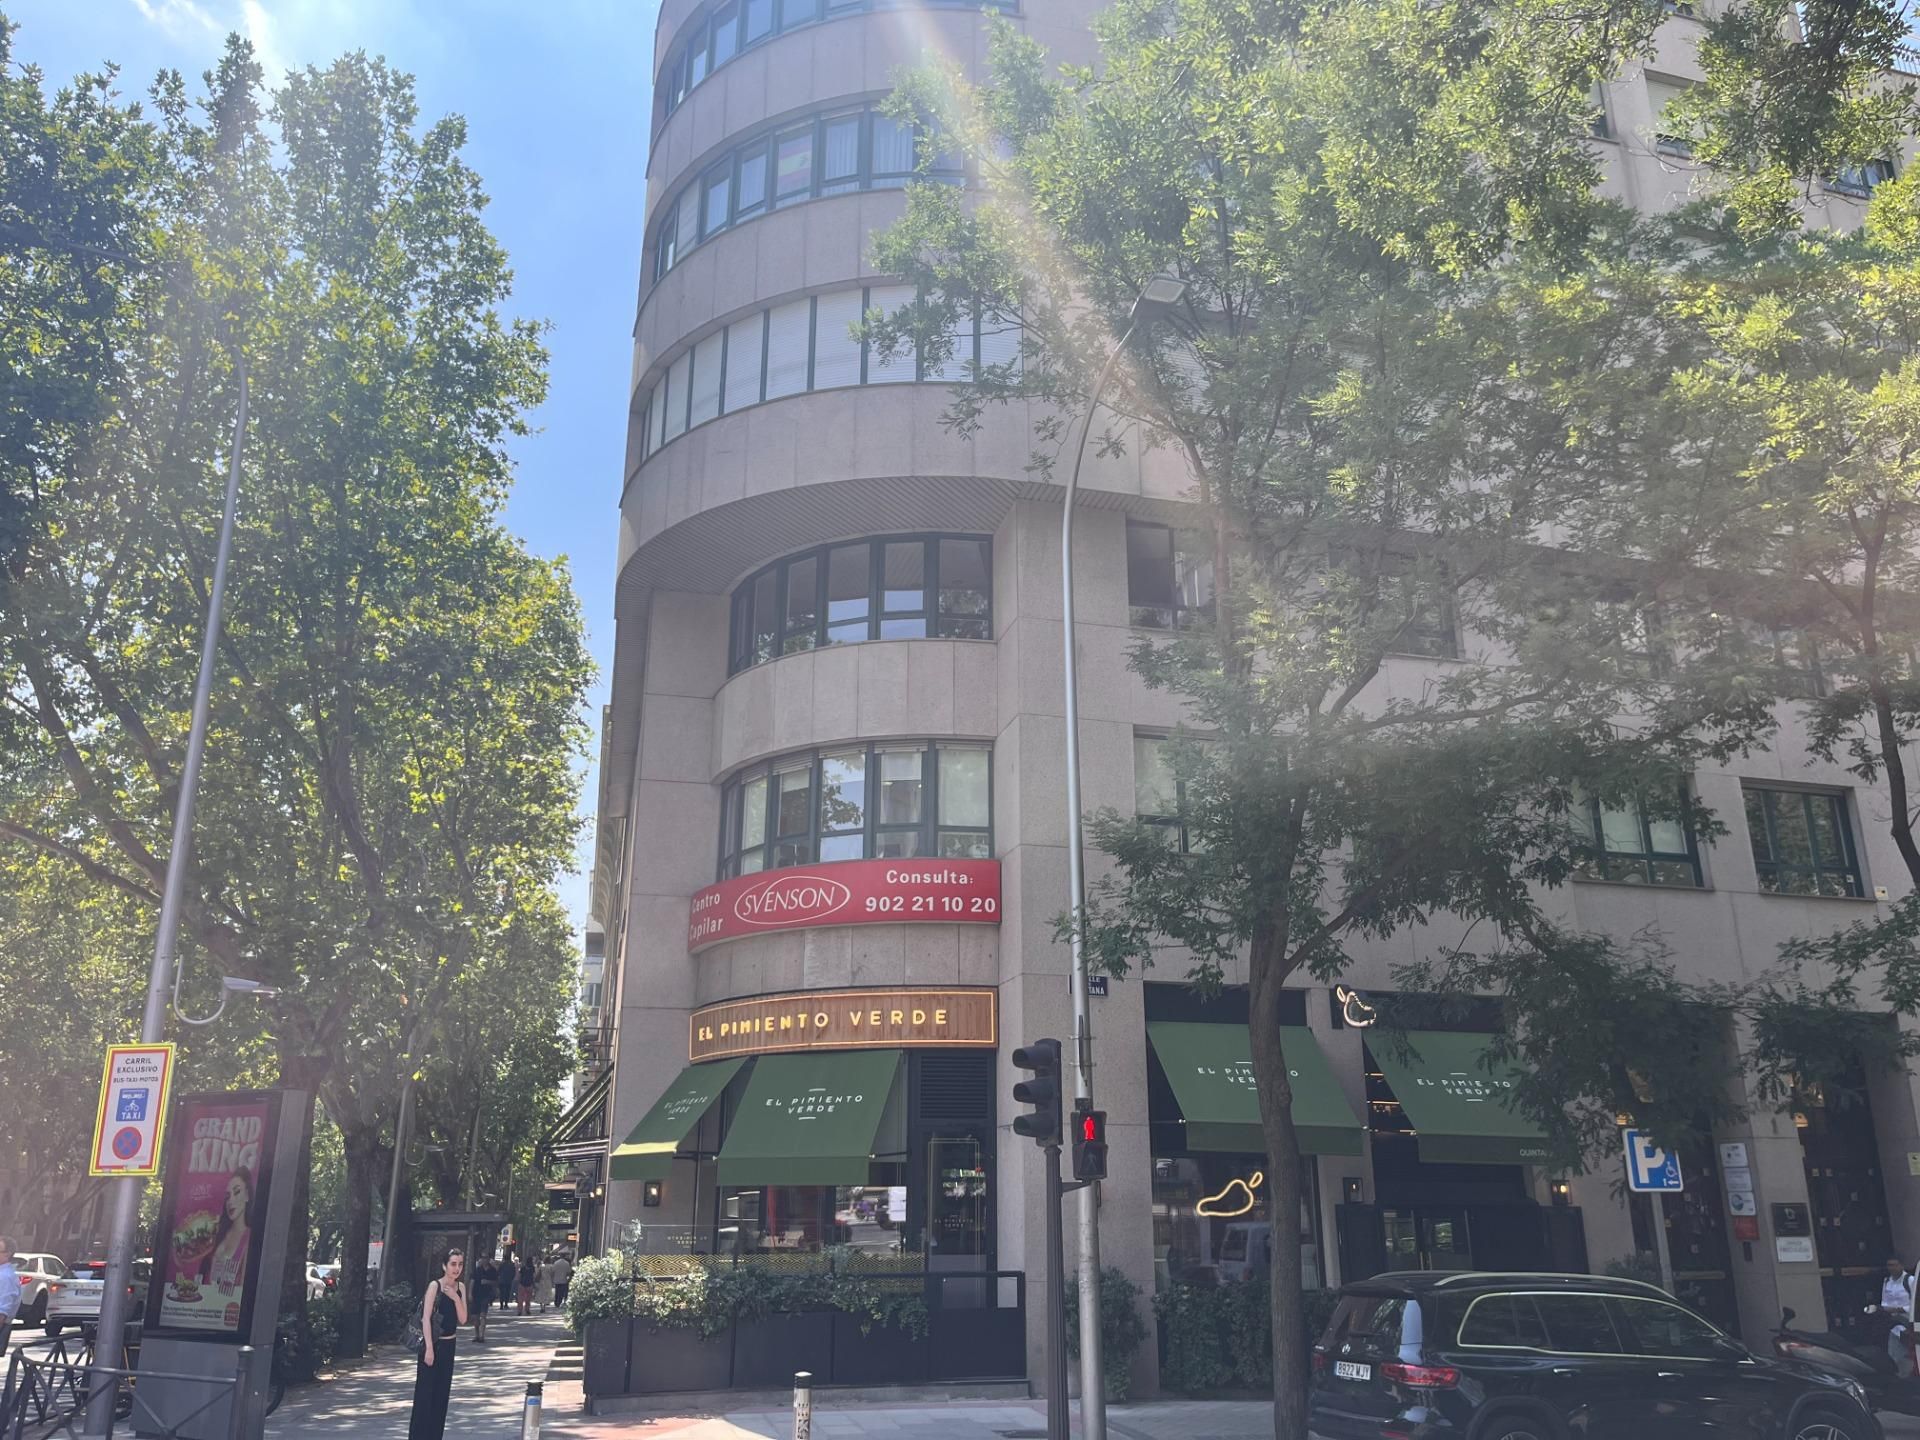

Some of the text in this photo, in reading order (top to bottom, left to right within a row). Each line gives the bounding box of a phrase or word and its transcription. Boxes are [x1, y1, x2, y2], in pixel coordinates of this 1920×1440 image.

[886, 869, 974, 885] Consulta:
[743, 886, 836, 916] SVENSON
[865, 896, 996, 913] 902 21 10 20
[699, 1009, 948, 1041] EL PIMIENTO VERDE
[125, 1057, 152, 1065] CARRIL
[117, 1066, 158, 1074] EXCLUSIVO
[1197, 1067, 1299, 1077] EL PIMO
[1227, 1076, 1256, 1084] VER
[1416, 1078, 1511, 1088] EL PIMIETO
[765, 1095, 863, 1106] EL PIMIENTO
[788, 1105, 835, 1115] VERDE
[121, 1111, 141, 1120] TAXI
[193, 1116, 262, 1142] GRAND
[188, 1140, 260, 1173] KING
